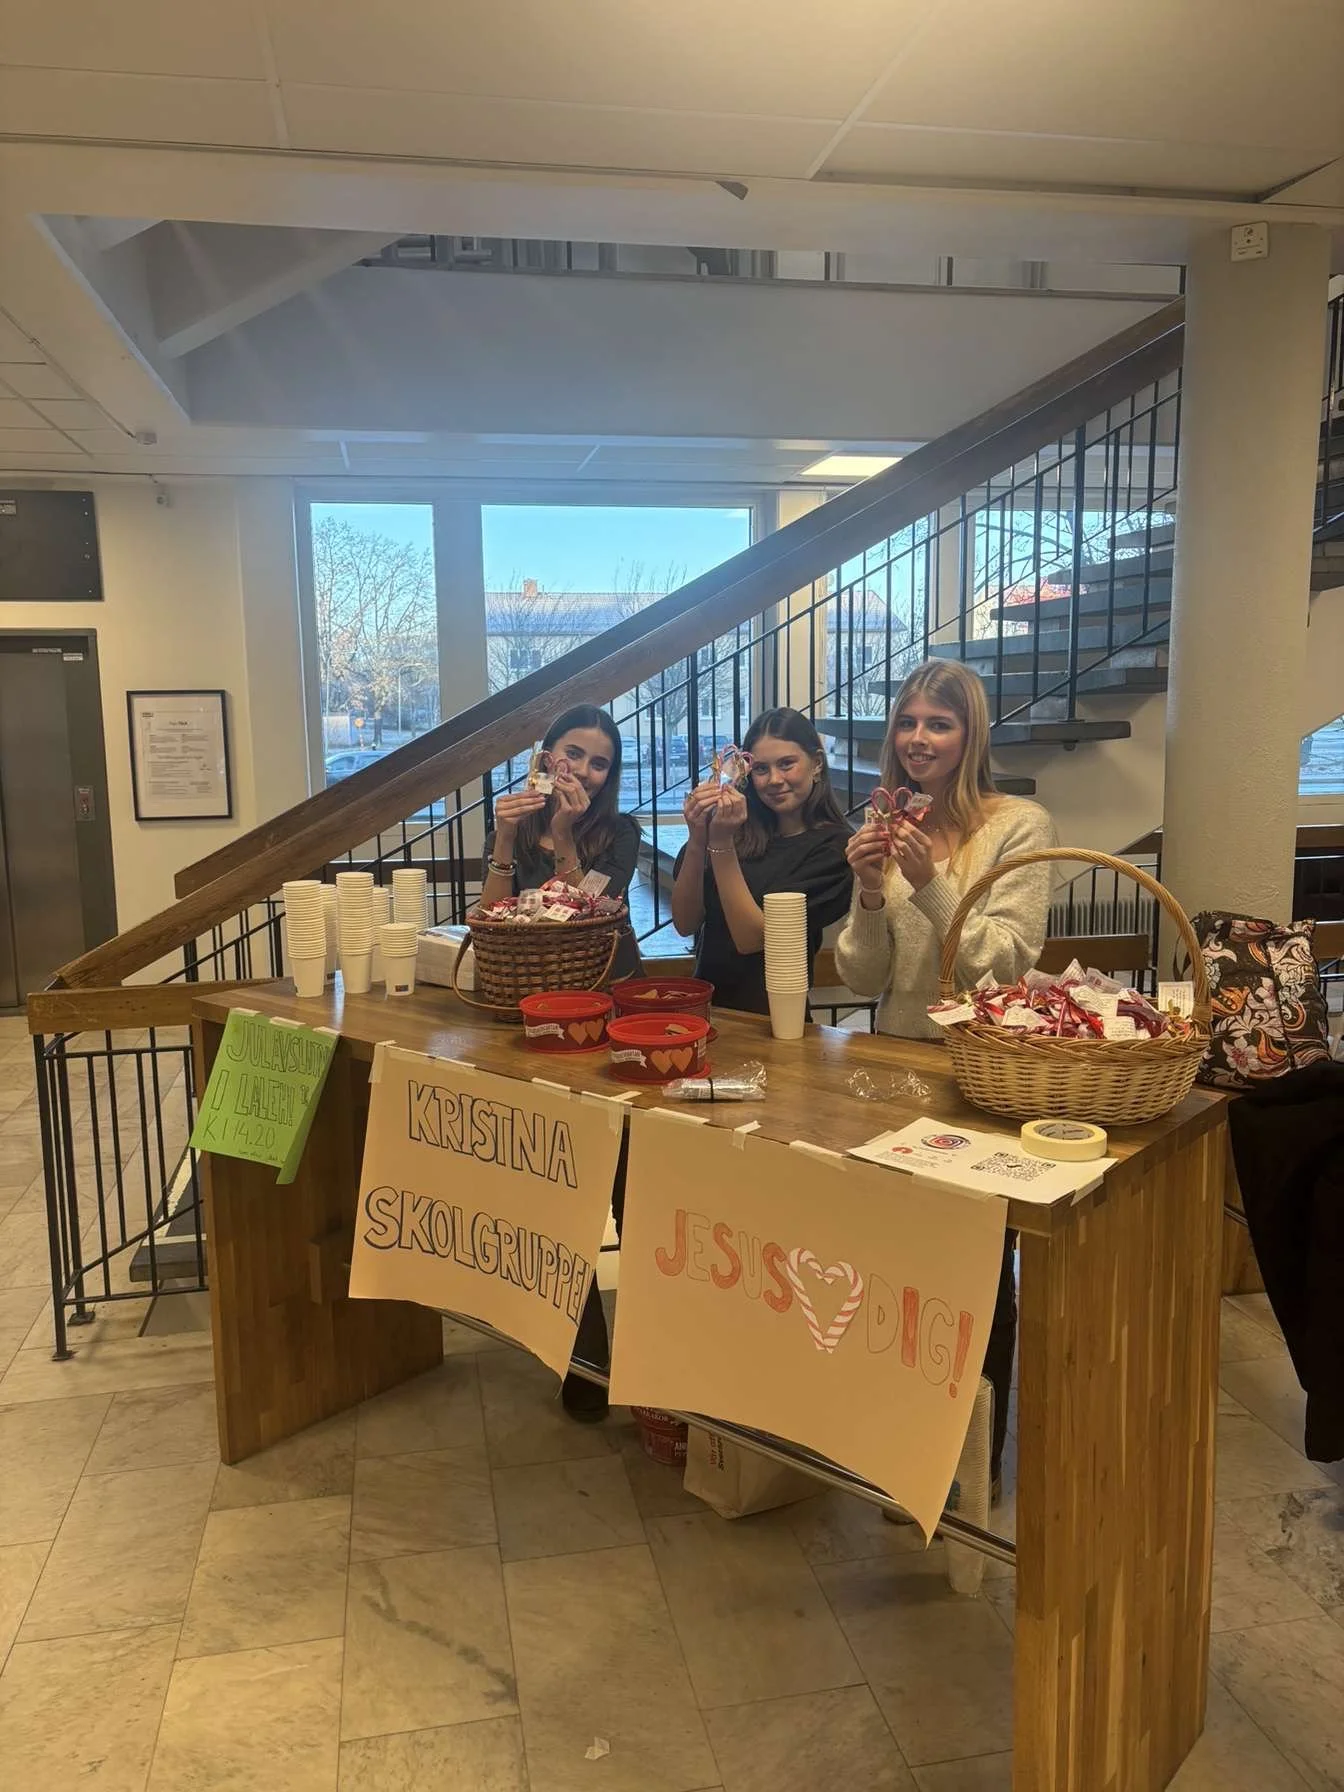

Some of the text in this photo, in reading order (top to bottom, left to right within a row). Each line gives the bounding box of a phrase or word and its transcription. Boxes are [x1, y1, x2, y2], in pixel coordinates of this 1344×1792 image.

[210, 1069, 230, 1110] I
[232, 1118, 276, 1149] 14.20
[408, 1080, 578, 1189] KRISTNA
[655, 1208, 975, 1399] JESUS DIG!
